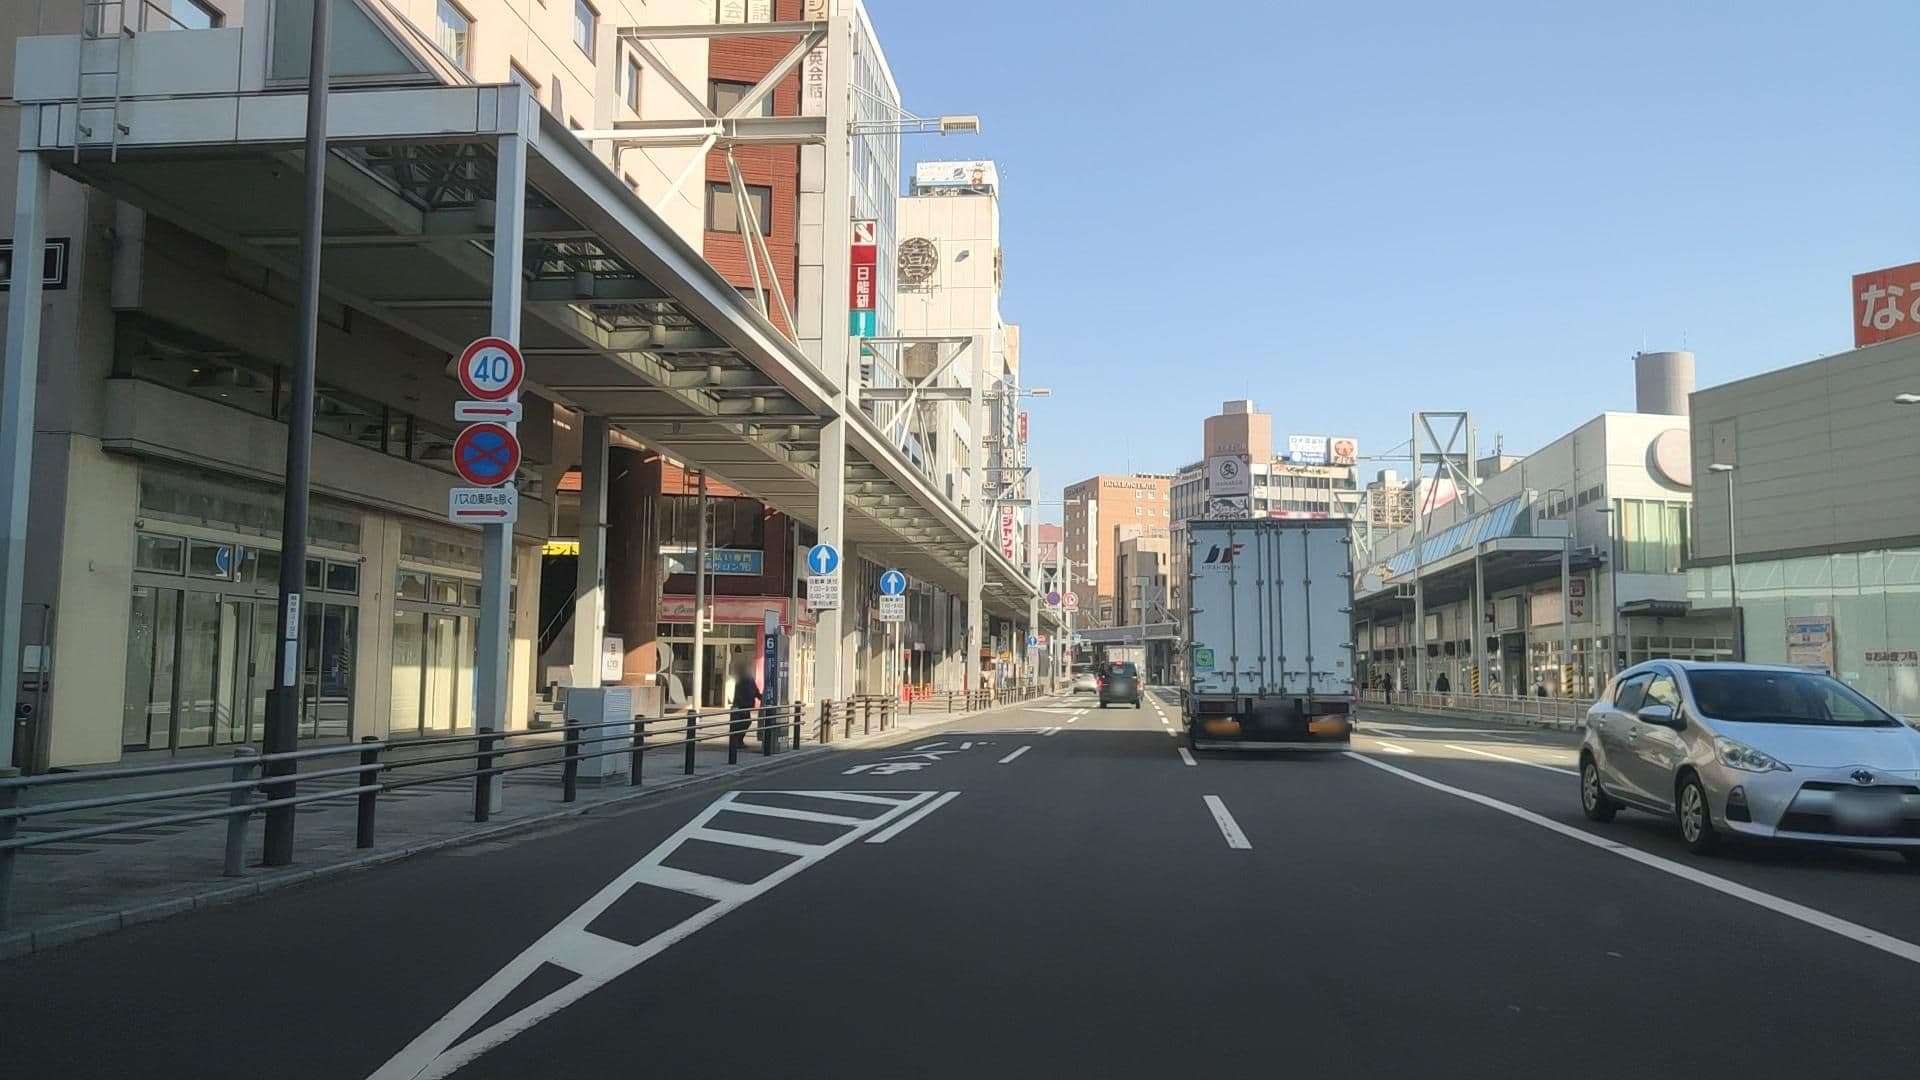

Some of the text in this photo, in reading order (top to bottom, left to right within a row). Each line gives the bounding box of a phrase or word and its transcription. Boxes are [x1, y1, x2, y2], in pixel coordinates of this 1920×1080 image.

[856, 266, 870, 308] 日能研
[473, 355, 509, 383] 40
[454, 493, 513, 506] バスの乗降を除く
[766, 637, 775, 650] 6
